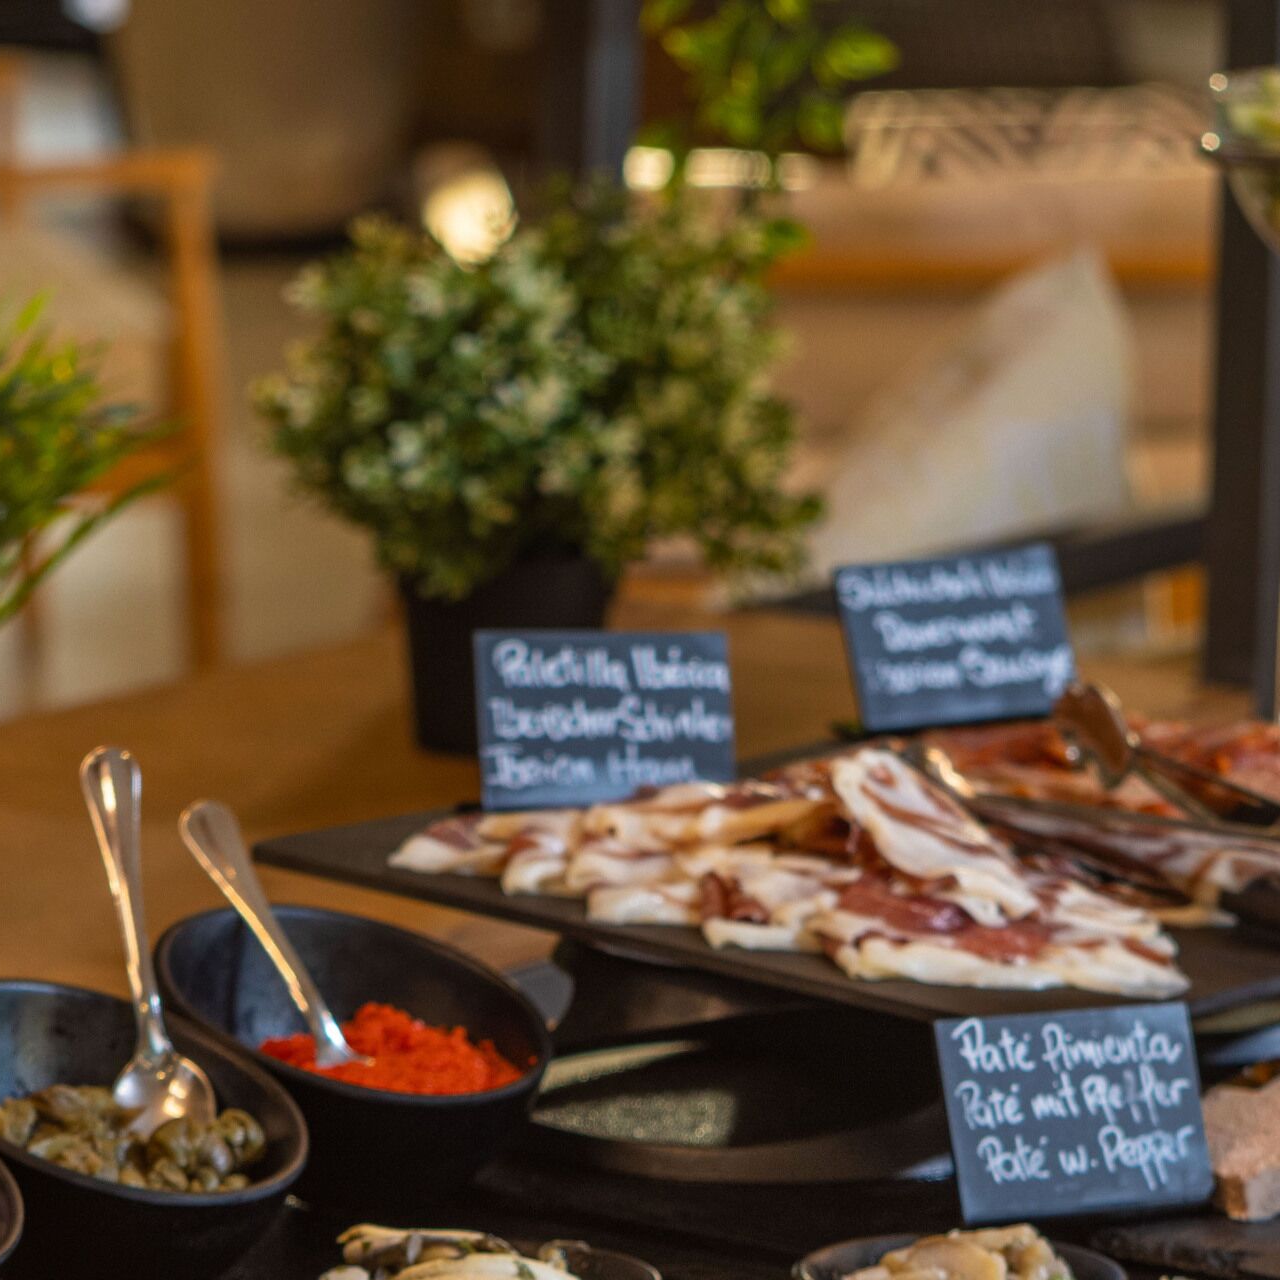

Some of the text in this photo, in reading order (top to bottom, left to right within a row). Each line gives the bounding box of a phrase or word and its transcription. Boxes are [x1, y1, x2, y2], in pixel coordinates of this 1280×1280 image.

[1030, 1070, 1081, 1119] mit
[1057, 1145, 1099, 1176] w.
[1097, 1122, 1196, 1192] Pepper
